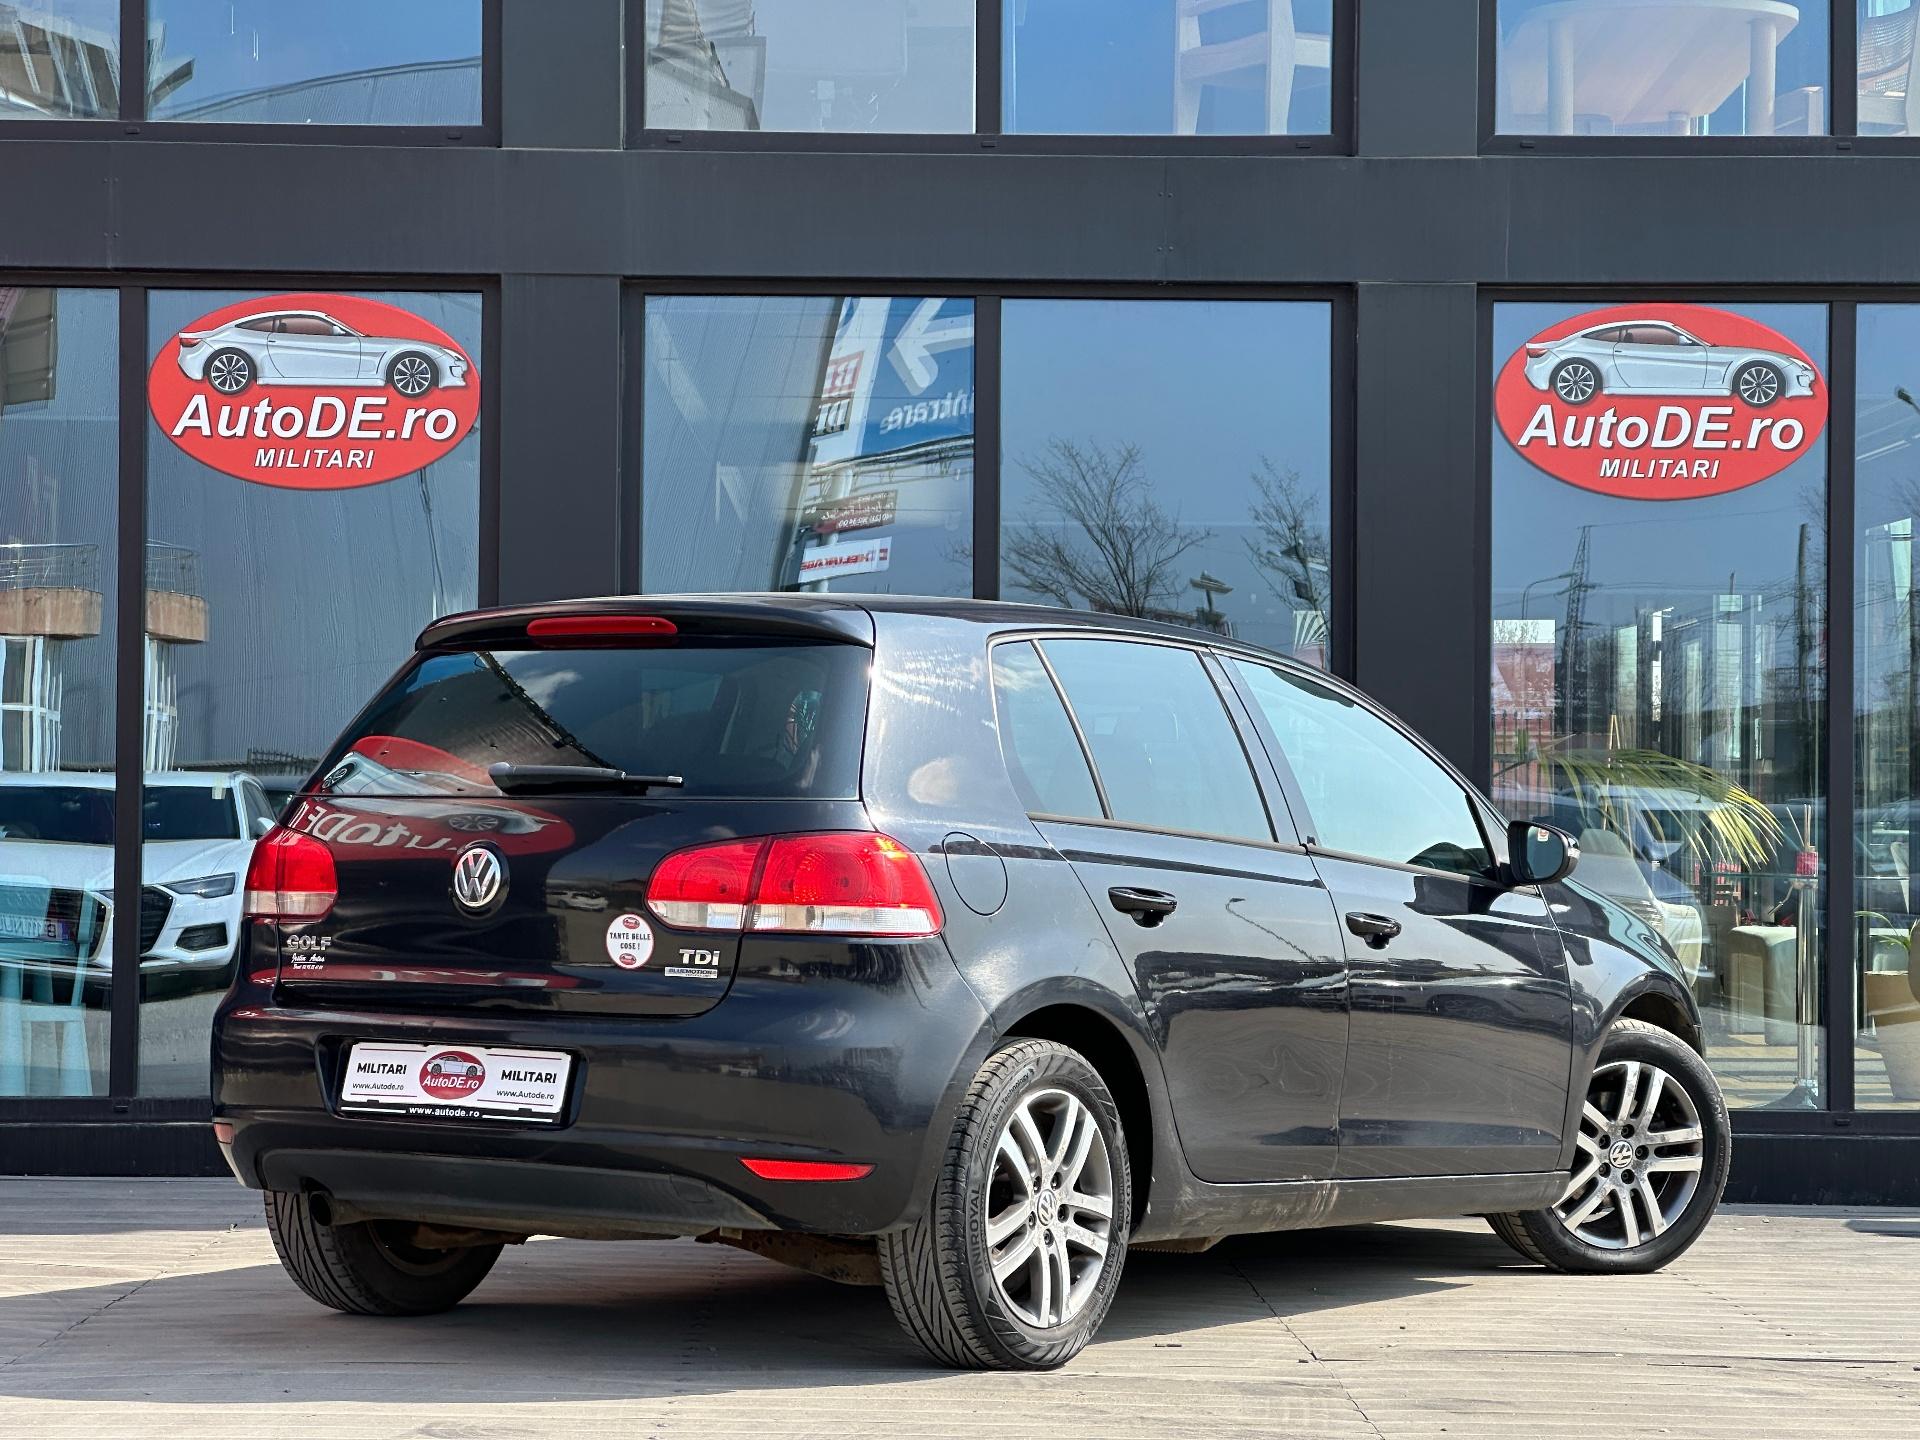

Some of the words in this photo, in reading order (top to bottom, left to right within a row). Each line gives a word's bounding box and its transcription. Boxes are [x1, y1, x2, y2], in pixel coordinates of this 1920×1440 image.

[171, 394, 458, 440] AutoDE.ro
[1517, 404, 1804, 450] AutoDE.ro
[254, 448, 375, 469] MILITARI
[1599, 458, 1720, 479] MILITARI
[286, 934, 331, 950] GOLF
[609, 932, 630, 940] TANTE
[631, 933, 651, 941] BELLE
[620, 942, 637, 950] COSE
[679, 949, 720, 966] TDI
[356, 1063, 407, 1075] MILITARI
[422, 1075, 480, 1090] AutoDE.ro
[501, 1070, 557, 1084] MILITARI
[352, 1082, 405, 1091] www.Autode.ro
[496, 1089, 555, 1100] www.Autode.ro
[409, 1106, 480, 1118] www.autode.ro
[969, 1184, 984, 1278] UNIROYAL
